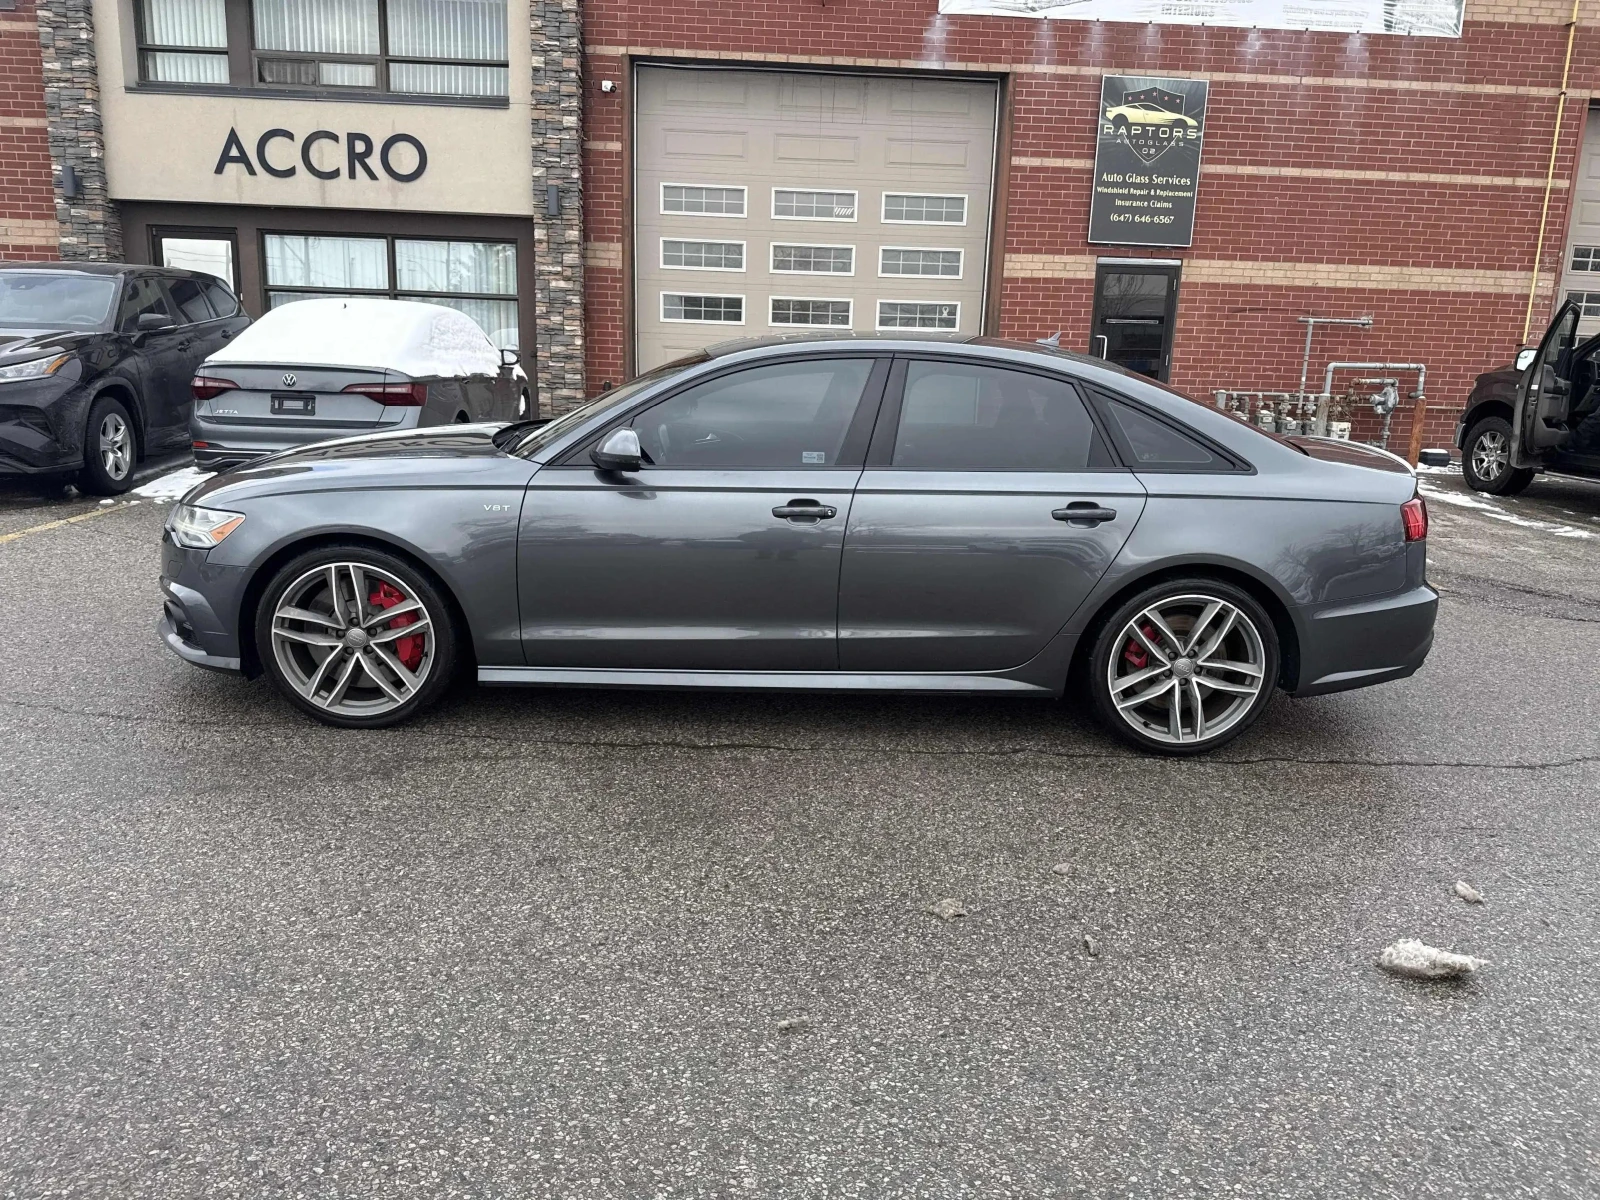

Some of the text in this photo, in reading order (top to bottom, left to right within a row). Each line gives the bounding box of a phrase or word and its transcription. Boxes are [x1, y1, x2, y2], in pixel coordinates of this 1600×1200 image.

[1103, 125, 1198, 139] RAPTORS
[214, 126, 428, 183] ACCRO
[1101, 172, 1191, 185] Auto Glass Services
[1096, 186, 1129, 195] Windshield
[1129, 188, 1149, 196] Repair
[1156, 189, 1193, 198] Replacement
[1115, 198, 1173, 208] Insurance Claims
[1110, 213, 1175, 224] (647) 646-6567
